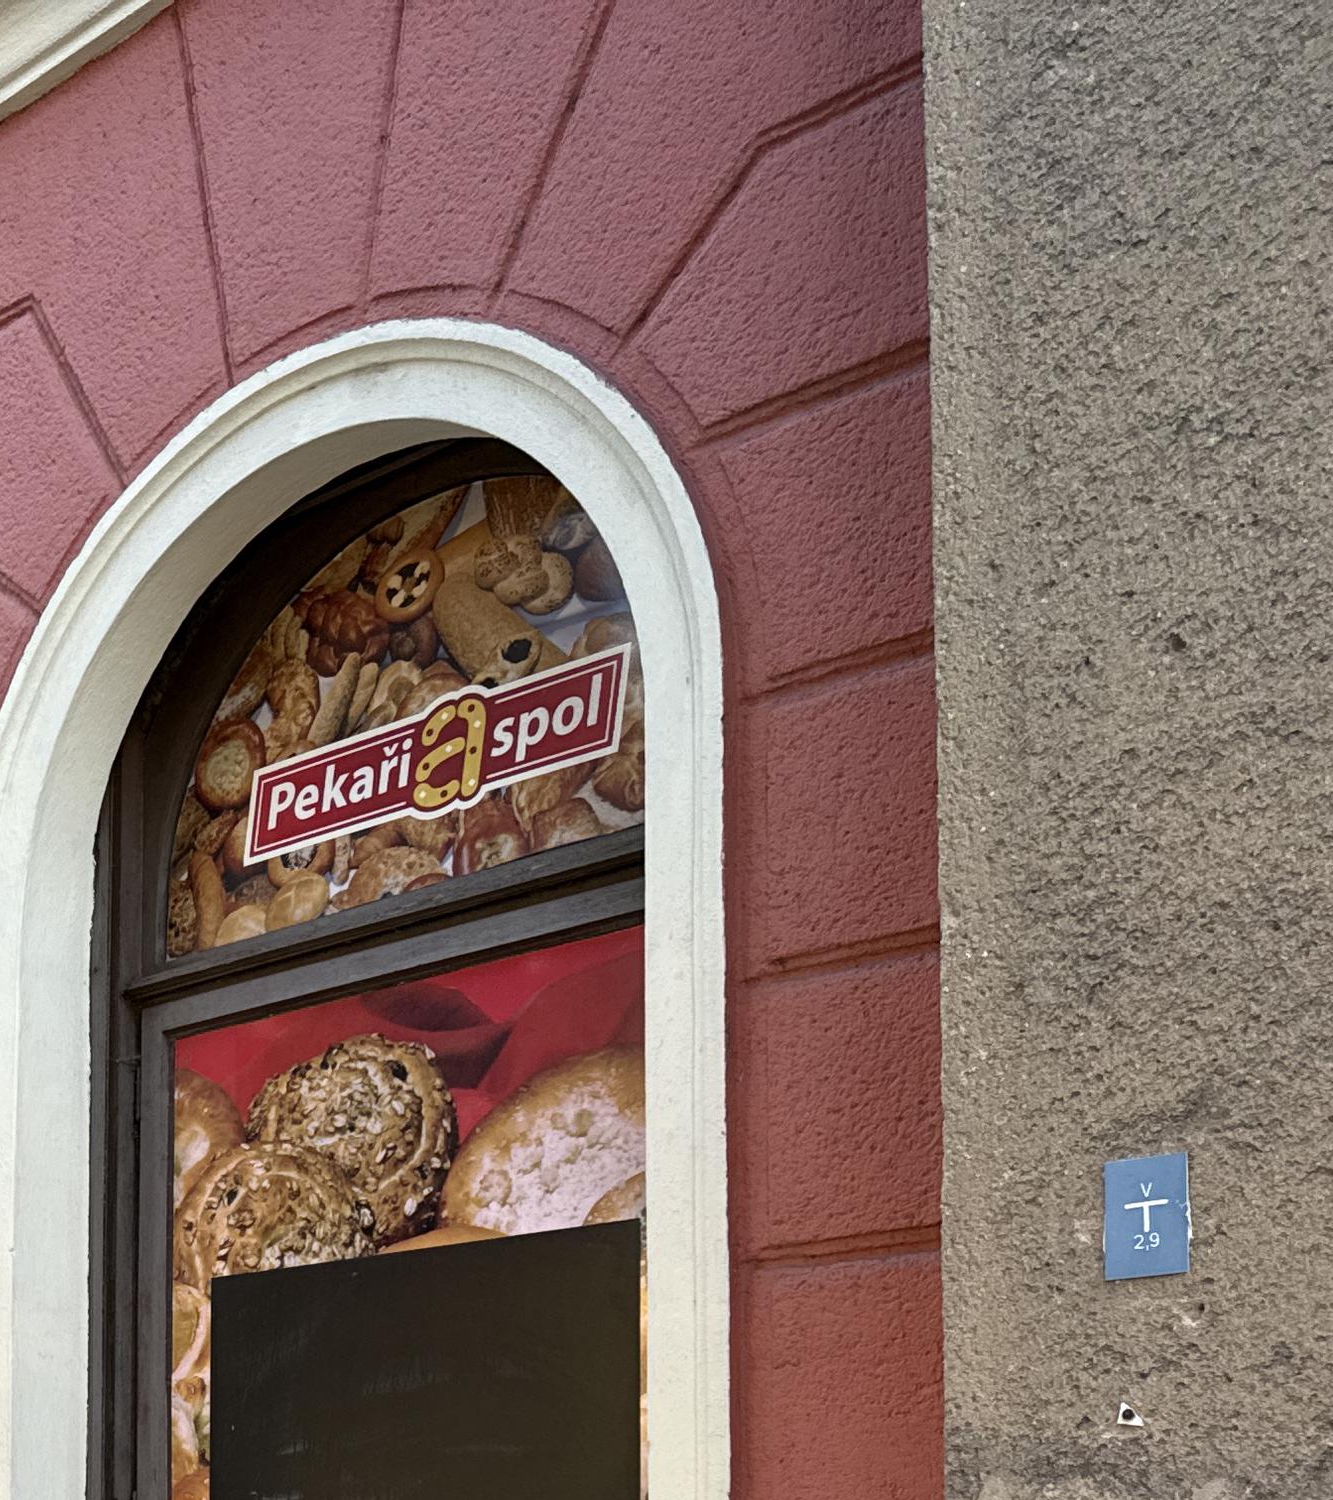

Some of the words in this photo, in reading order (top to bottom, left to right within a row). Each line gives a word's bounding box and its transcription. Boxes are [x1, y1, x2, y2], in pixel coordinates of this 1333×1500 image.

[267, 737, 414, 831] Pekaři
[490, 672, 603, 763] spol
[1133, 1232, 1160, 1251] 2,9
